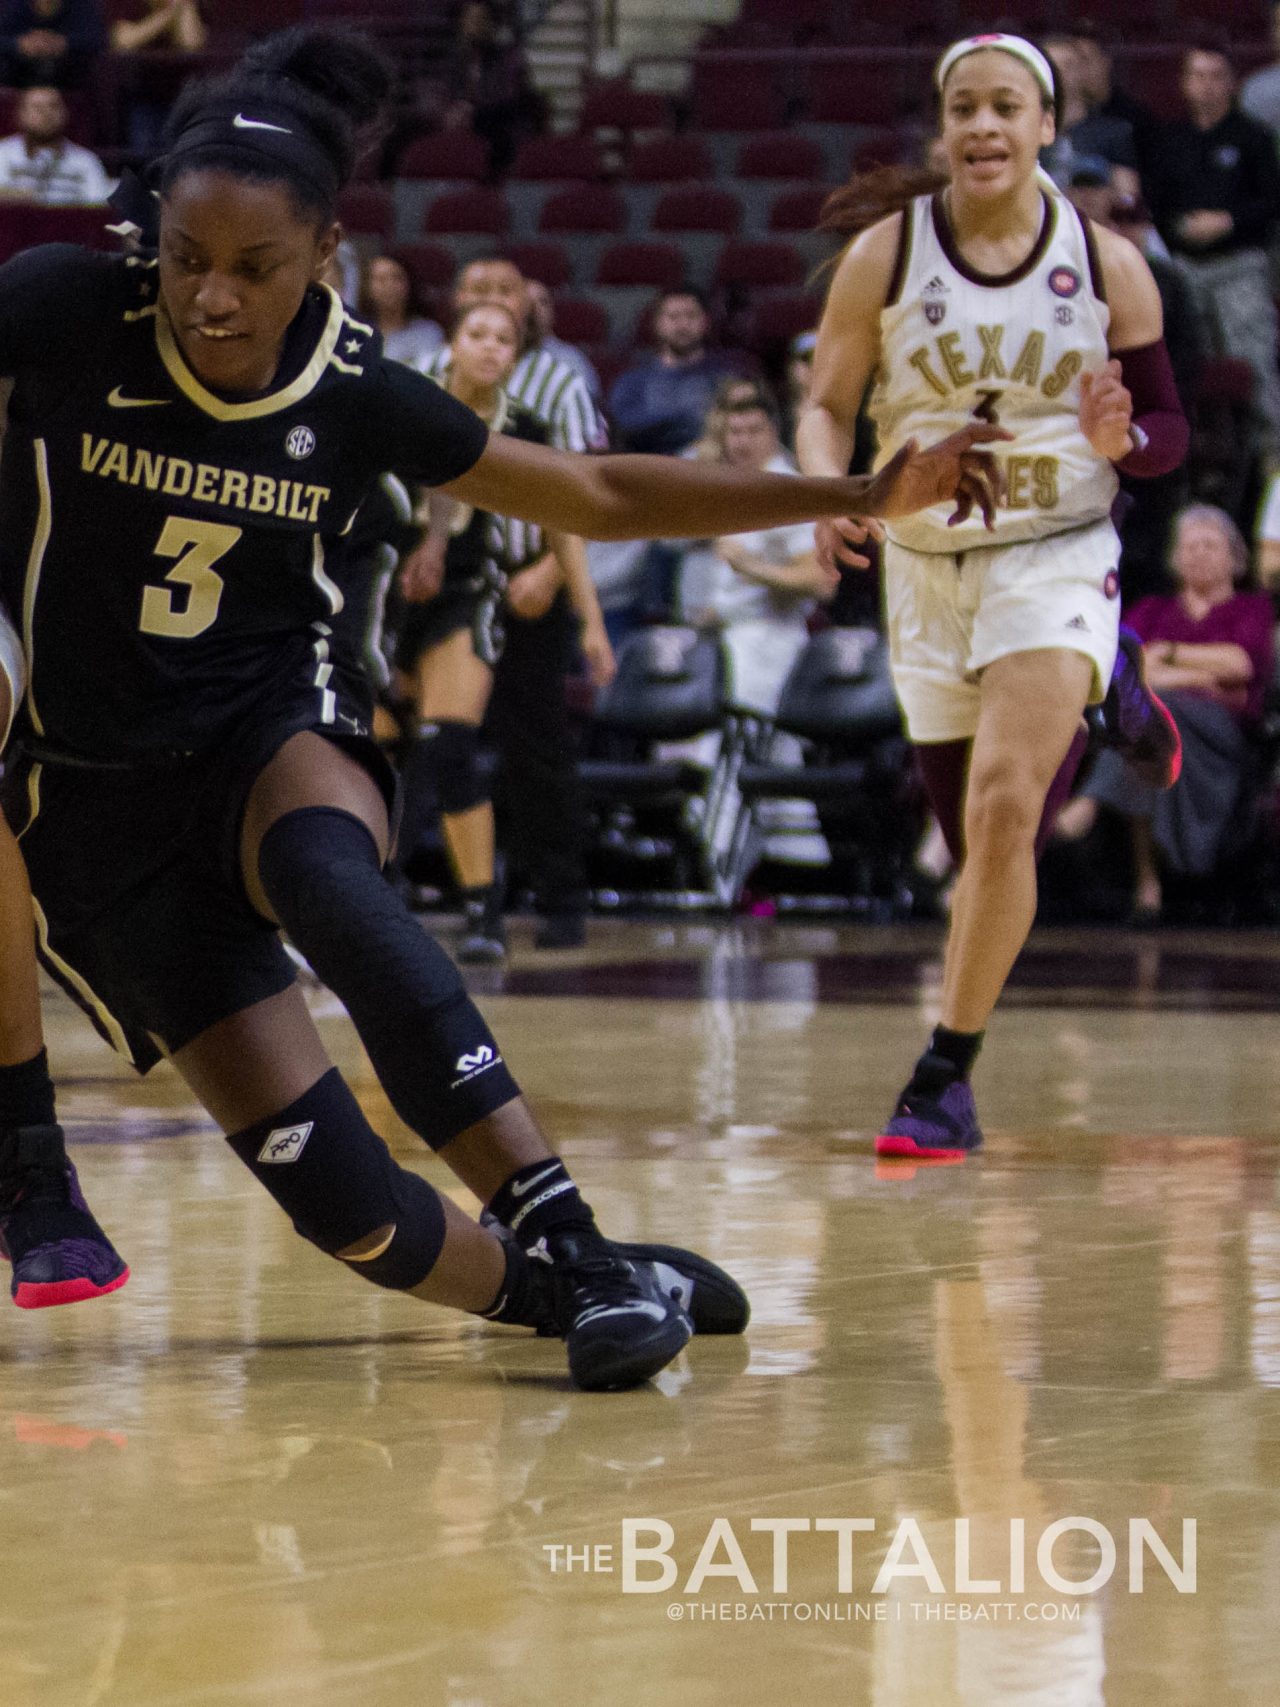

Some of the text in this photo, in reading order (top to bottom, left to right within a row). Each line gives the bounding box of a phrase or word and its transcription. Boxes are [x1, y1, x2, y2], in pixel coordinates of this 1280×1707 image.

[907, 323, 1083, 398] TEXAS
[81, 432, 331, 522] VANDERBILT
[288, 427, 314, 457] SEC
[138, 515, 243, 638] 3
[270, 1132, 301, 1158] PRO
